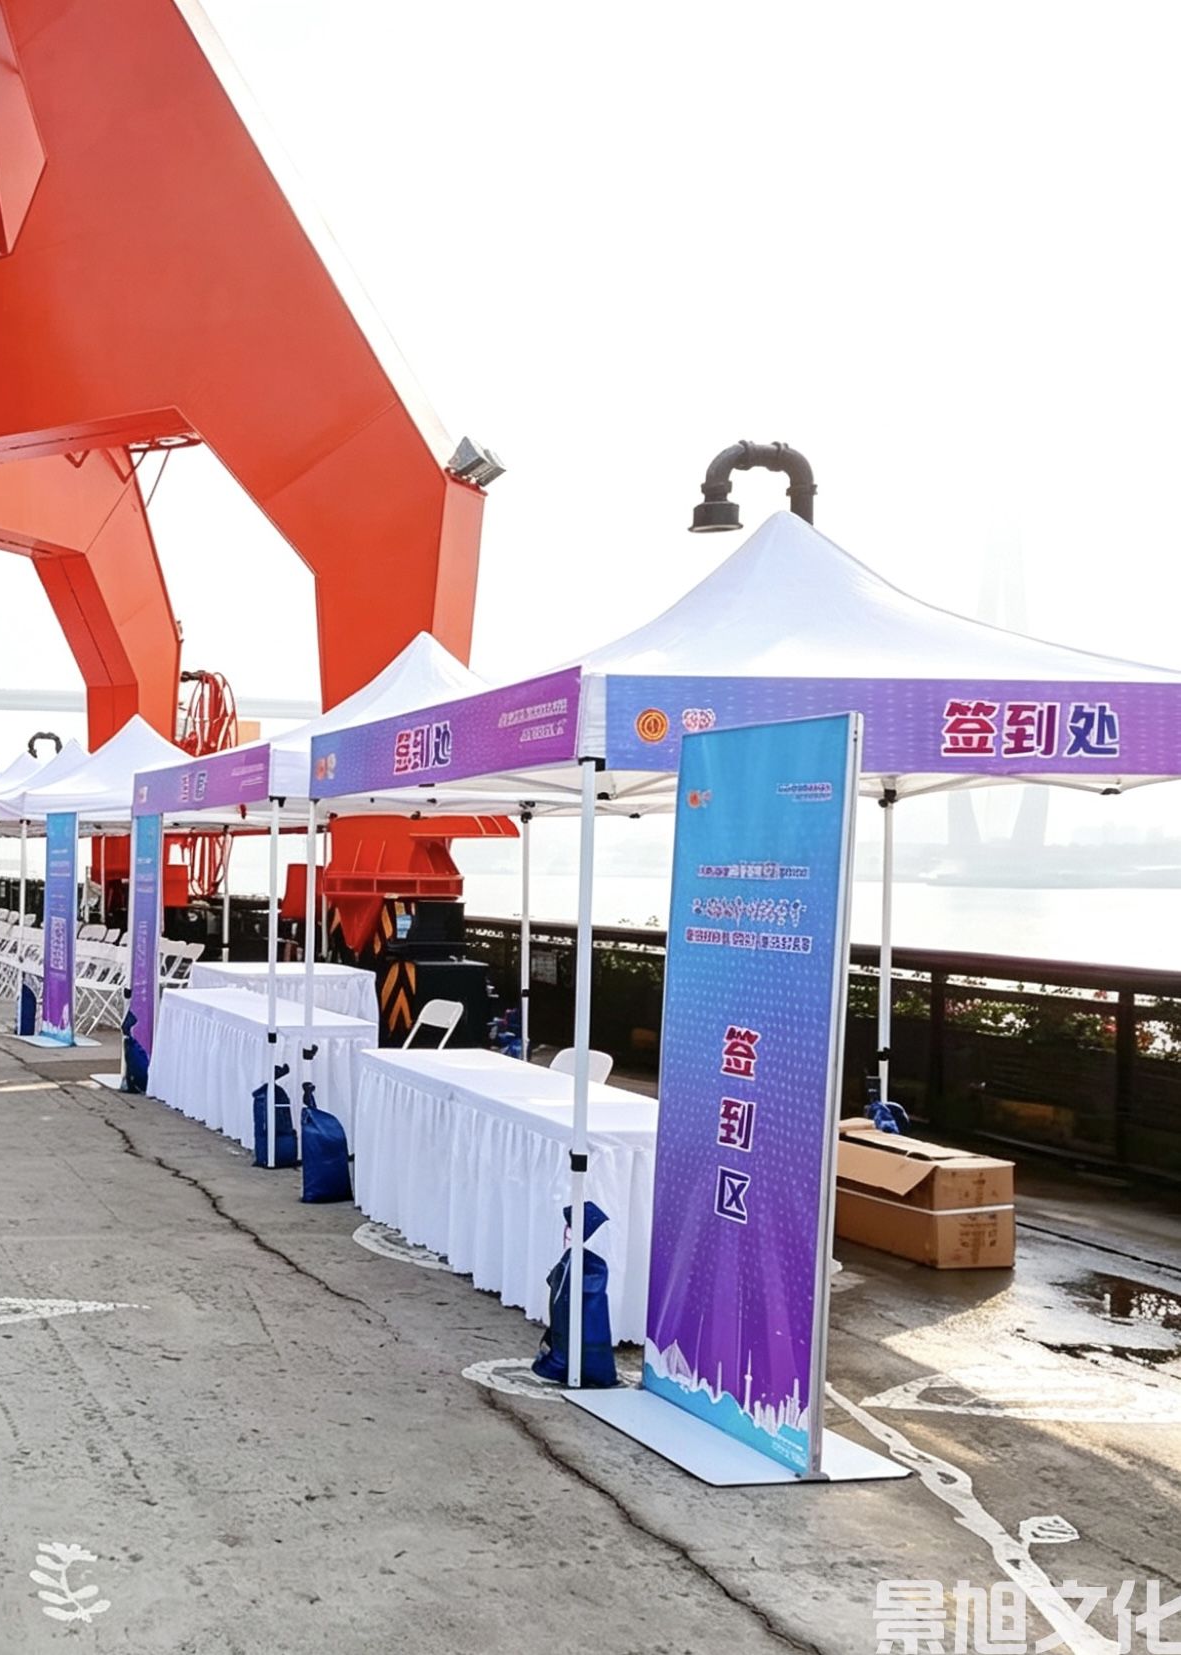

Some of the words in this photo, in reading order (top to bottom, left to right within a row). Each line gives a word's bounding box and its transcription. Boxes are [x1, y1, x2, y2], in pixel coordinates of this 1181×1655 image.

[942, 700, 1119, 758] 签到处
[715, 1025, 761, 1224] 签到区
